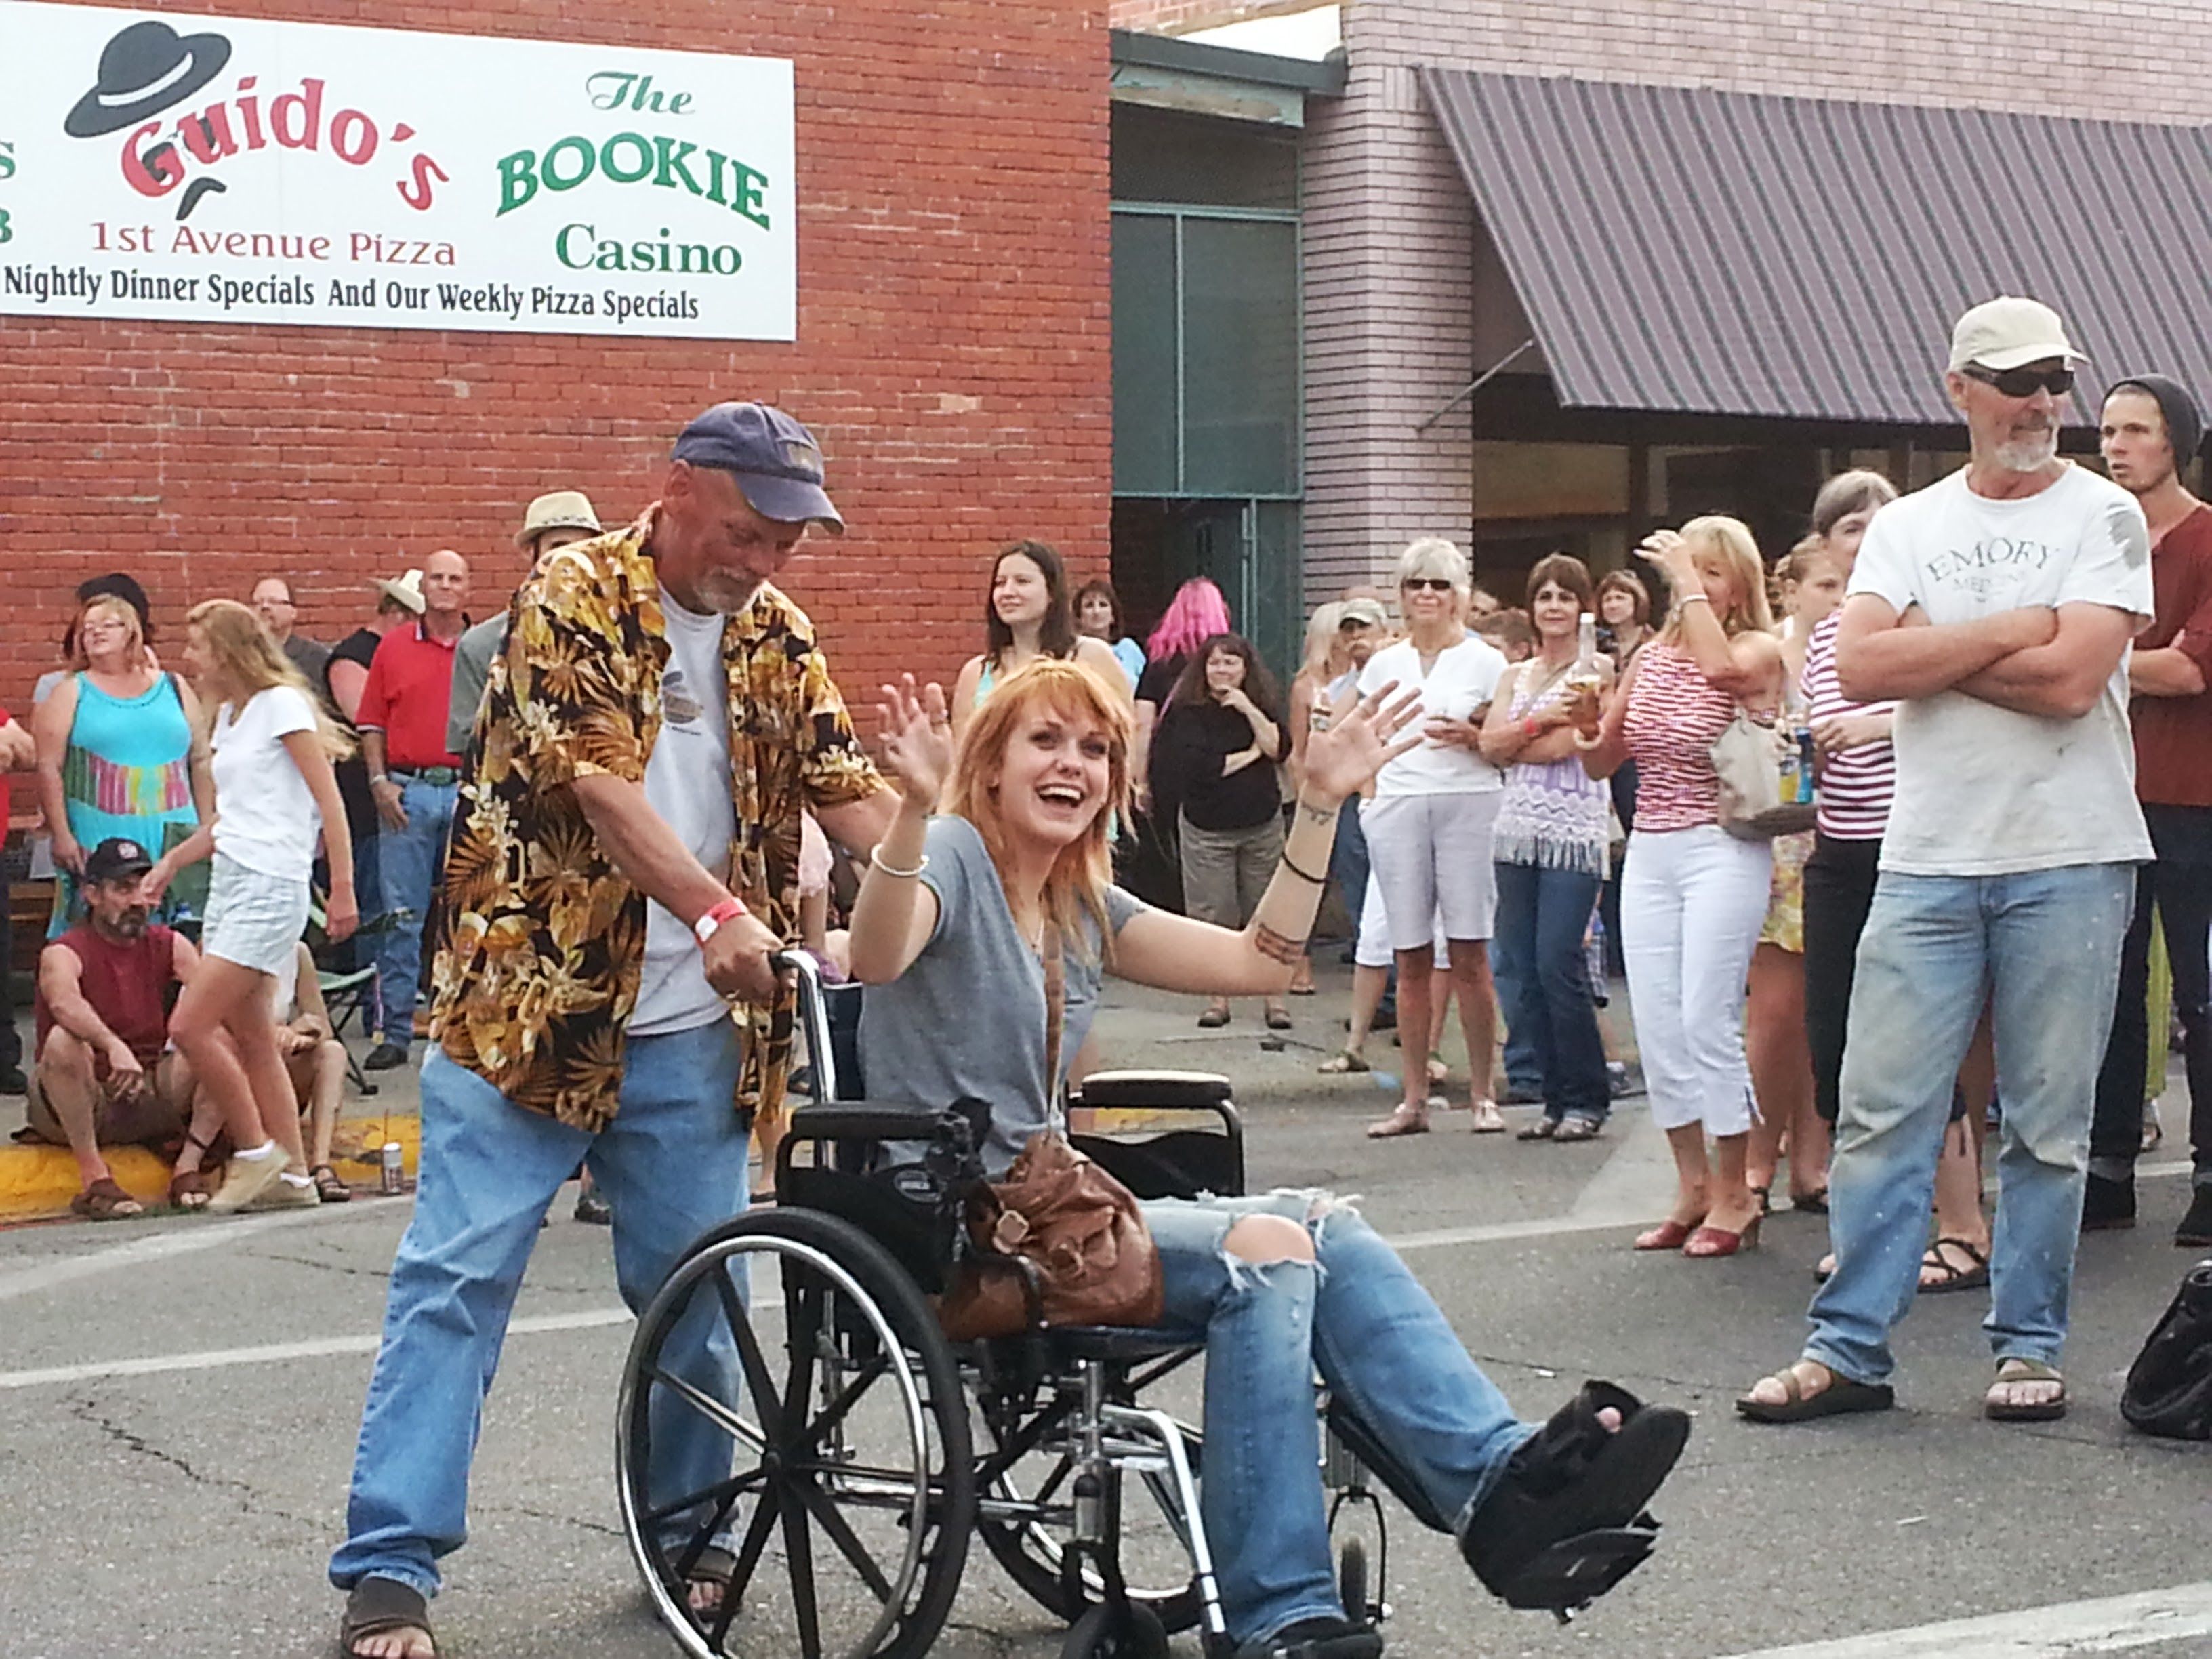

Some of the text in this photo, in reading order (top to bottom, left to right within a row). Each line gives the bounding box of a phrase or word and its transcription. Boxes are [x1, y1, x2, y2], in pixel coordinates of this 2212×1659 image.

[586, 71, 695, 115] The
[121, 76, 450, 211] Guido's
[495, 131, 771, 231] BOOKIE
[91, 222, 456, 266] 1st Avenue Pizza
[556, 223, 742, 275] Casino
[4, 264, 699, 325] Nightly Dinner Specials And Our Weekly Pizza Specials
